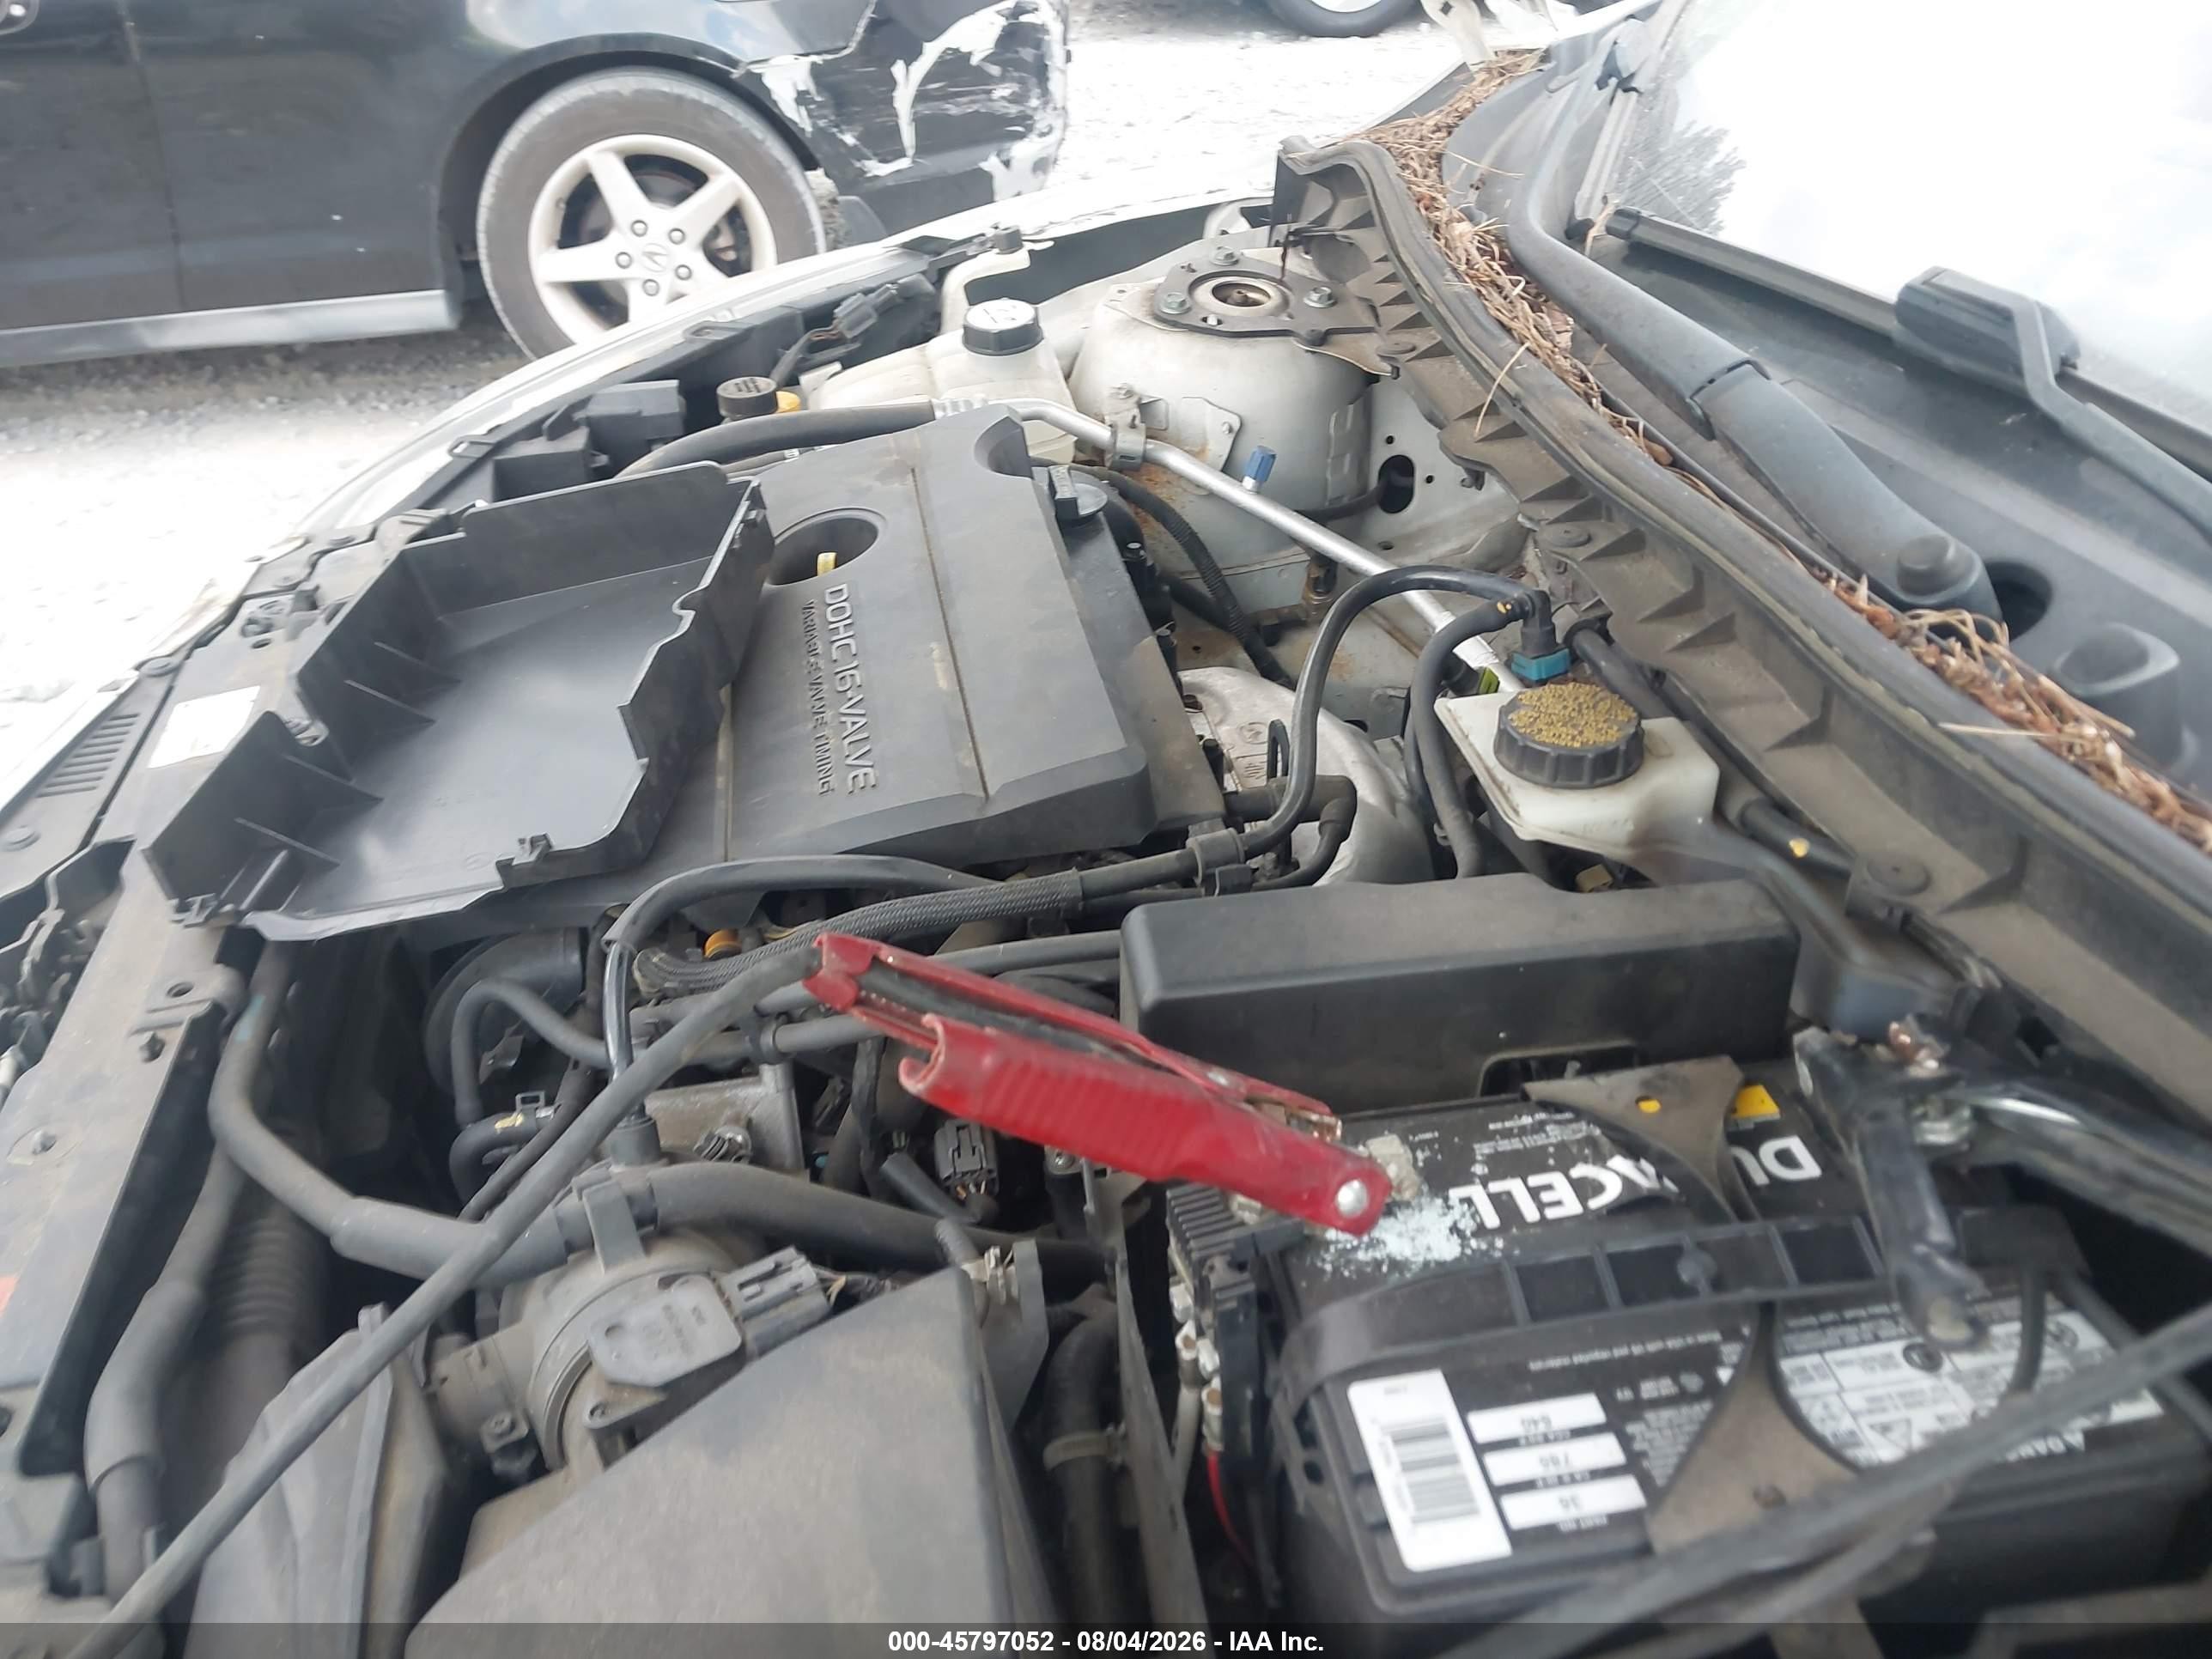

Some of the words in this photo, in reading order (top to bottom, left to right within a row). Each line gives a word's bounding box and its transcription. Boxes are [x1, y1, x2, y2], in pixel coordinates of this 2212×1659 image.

[824, 583, 857, 662] DOHC
[832, 661, 878, 795] 16-VALVE
[1448, 1133, 1821, 1230] DUACELL
